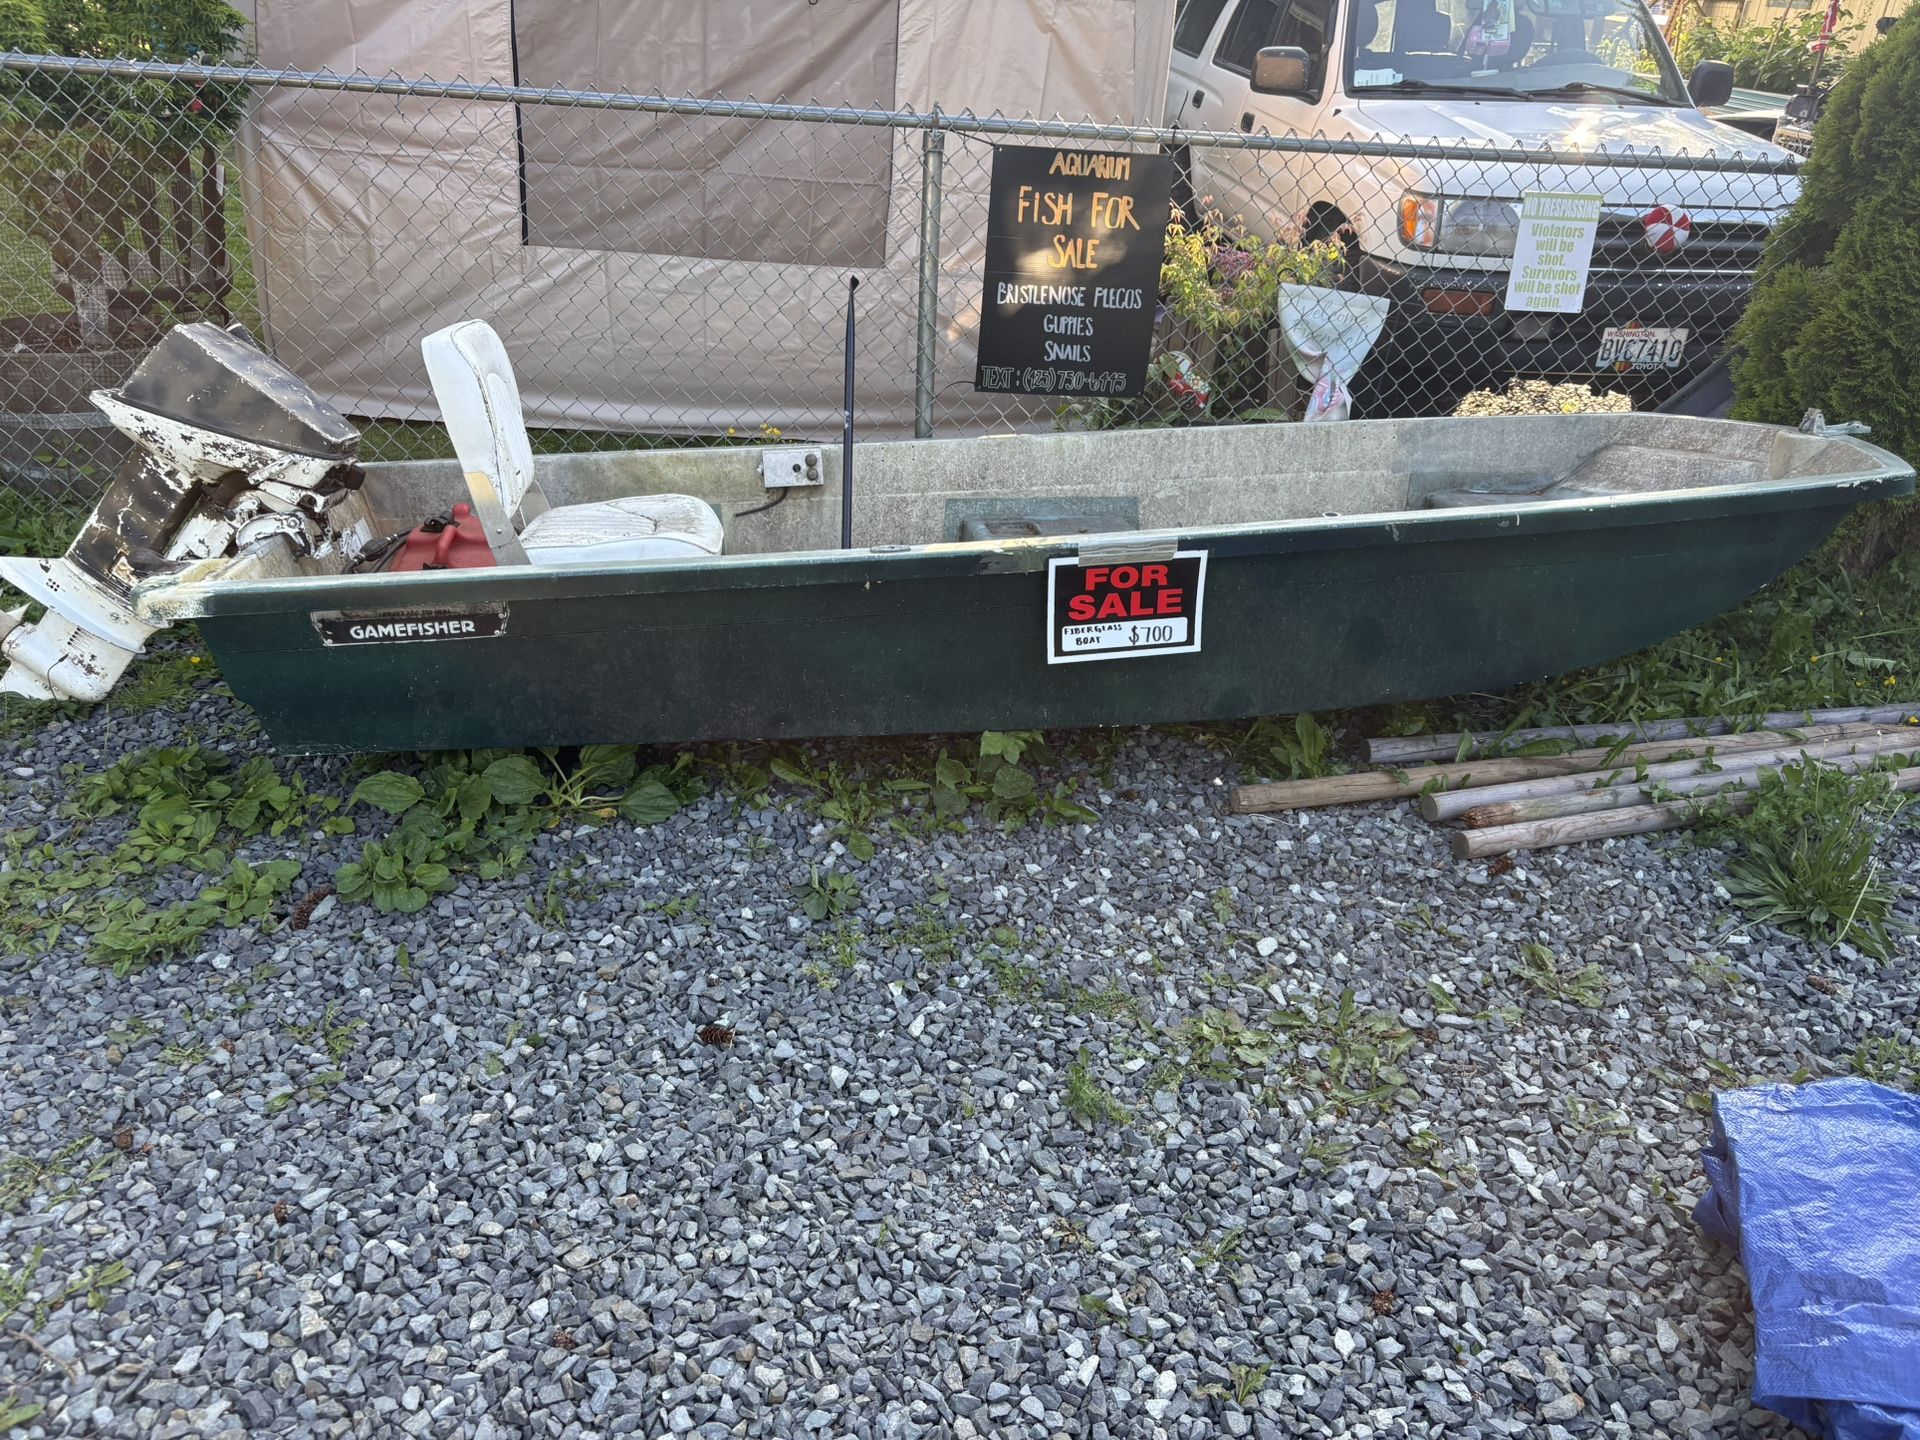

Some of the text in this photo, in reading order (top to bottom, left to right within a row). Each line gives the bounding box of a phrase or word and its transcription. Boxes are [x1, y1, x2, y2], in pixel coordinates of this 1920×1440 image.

[1049, 151, 1131, 181] AQUARIUM
[1018, 185, 1140, 231] FISH FOR
[1524, 196, 1600, 219] NO TRESPASSING
[1531, 223, 1585, 239] Violators
[1048, 234, 1100, 270] SALE
[1535, 238, 1575, 253] will be
[1537, 252, 1566, 266] shot.
[1522, 266, 1578, 281] Survivors
[997, 281, 1143, 309] BRISTLENOSE PLECOS
[1514, 280, 1581, 295] will be shot
[1526, 294, 1562, 309] again.
[1043, 314, 1094, 337] GUPPIES
[1044, 340, 1091, 363] SNAILS
[1085, 564, 1169, 591] FOR
[1068, 588, 1183, 621] SALE
[350, 620, 476, 640] GAMEFISHER
[1064, 624, 1173, 646] FIBERGLASS $700
[1075, 636, 1101, 646] BOAT
